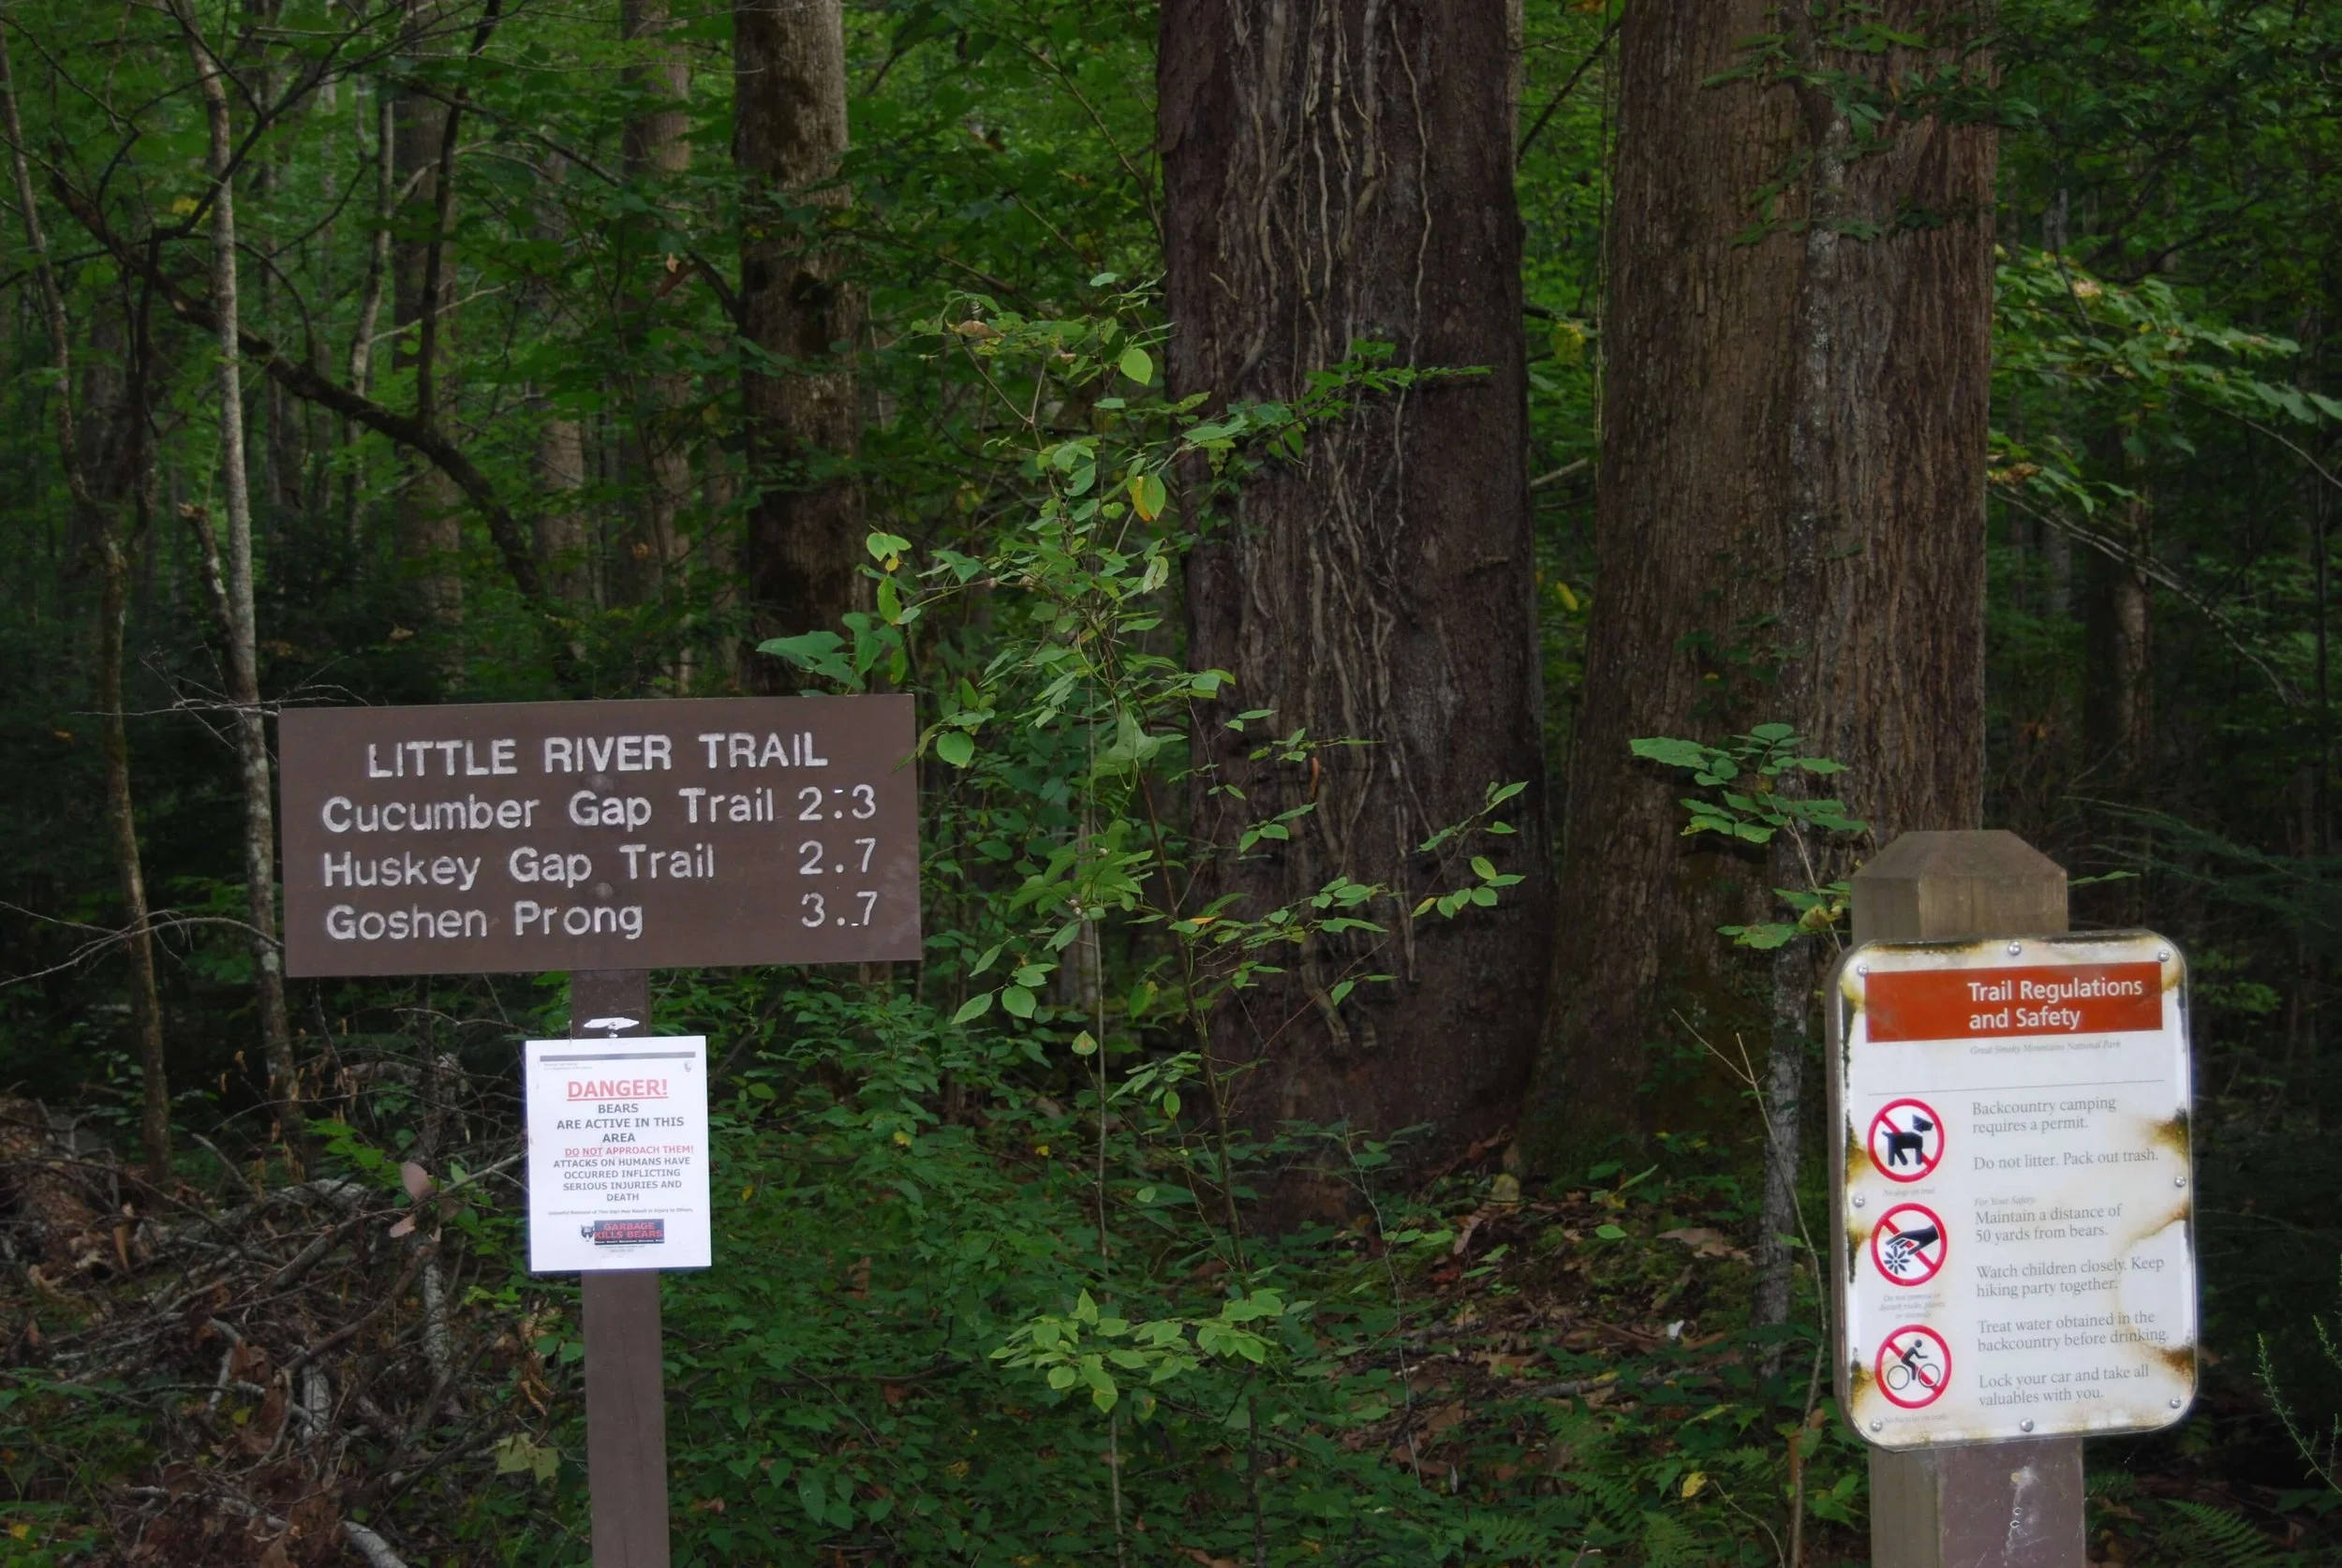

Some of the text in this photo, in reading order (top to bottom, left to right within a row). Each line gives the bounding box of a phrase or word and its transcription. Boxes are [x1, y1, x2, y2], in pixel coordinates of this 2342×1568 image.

[368, 732, 829, 777] LITTLE RIVER TRAIL
[322, 795, 541, 834] Cucumber
[569, 790, 652, 832] Gap
[679, 787, 775, 824] Trail
[323, 837, 876, 891] Huskey Gap Trail 2.7
[325, 891, 878, 940] Goshen Prong 3.7
[1968, 978, 2142, 1003] Trail Regulations
[1969, 1007, 2081, 1030] and Safety
[567, 1079, 668, 1098] DANGER!
[598, 1103, 639, 1115] BEARS
[1972, 1097, 2116, 1117] Backcountry camping
[556, 1117, 684, 1130] ARE ACTIVE IN THIS
[1972, 1116, 2088, 1135] requires a permit.
[602, 1132, 636, 1144] AREA
[565, 1145, 694, 1157] DO NOT APPROACH THEM!
[1974, 1148, 2158, 1170] Do not litter. Pack out trash.
[554, 1157, 690, 1168] ATTACKS ON HUMANS HAVE
[564, 1169, 680, 1179] OCCURRED INFLICTING
[563, 1180, 682, 1191] SERIOUS INJURIES AND
[606, 1192, 640, 1202] DEATH
[1975, 1205, 2122, 1224] Maintain a distance of
[594, 1229, 662, 1239] KILLS BEARS
[604, 1222, 655, 1231] GARBAGE
[1976, 1222, 2108, 1244] 50 yards from bears.
[1977, 1257, 2165, 1280] Watch children closely. Keep
[1977, 1278, 2117, 1299] hiking party together.
[1978, 1310, 2155, 1333] Treat water obtained in the
[1978, 1327, 2169, 1353] backcountry before drinking.
[1979, 1365, 2149, 1389] Lock your car and take all
[1979, 1387, 2104, 1406] valuables with you.
